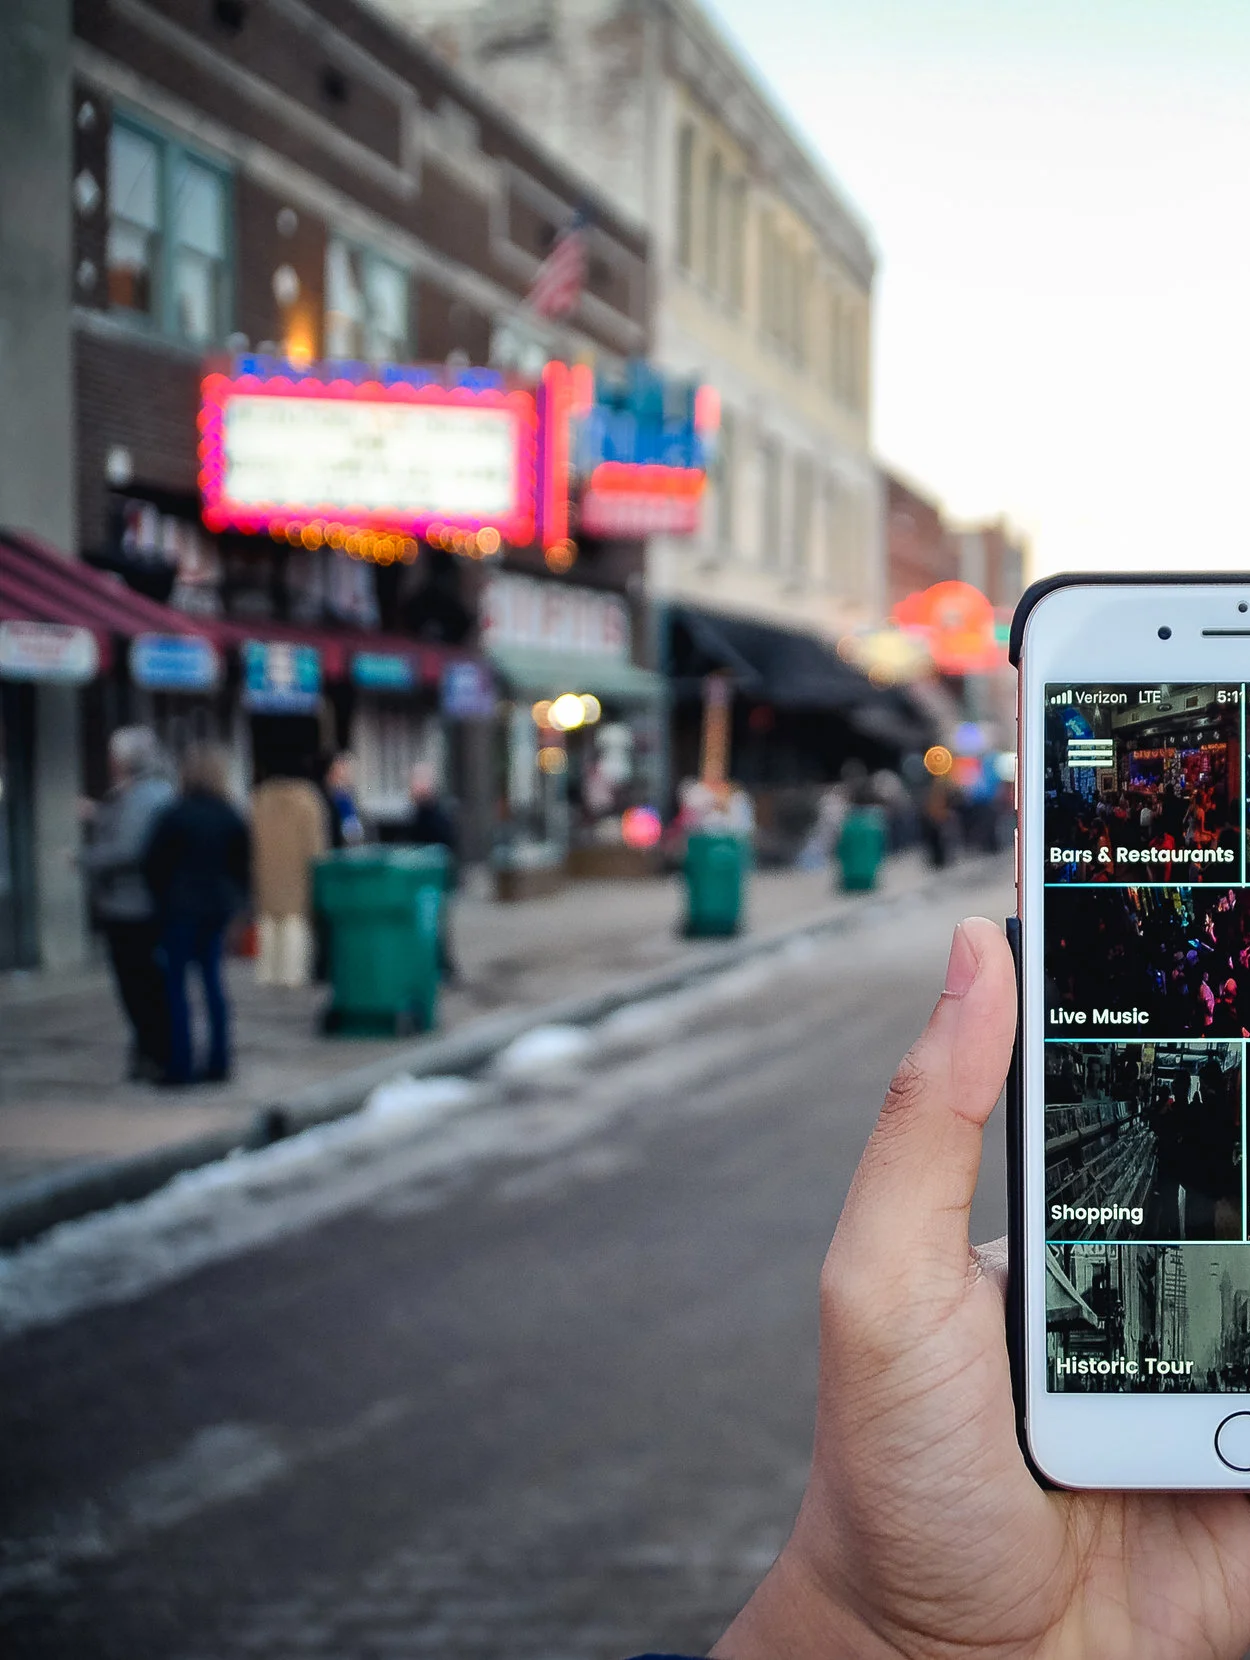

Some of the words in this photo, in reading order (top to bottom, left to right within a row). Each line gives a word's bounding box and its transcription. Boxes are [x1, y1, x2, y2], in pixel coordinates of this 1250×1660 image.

[1075, 690, 1127, 704] Verizon
[1138, 690, 1161, 704] LTE
[1050, 847, 1093, 863] Bars
[1097, 847, 1111, 863] &
[1116, 847, 1235, 863] Restaurants
[1050, 1007, 1087, 1025] Live
[1092, 1007, 1150, 1025] Music
[1051, 1203, 1144, 1226] Shopping
[1056, 1356, 1139, 1375] Historic
[1144, 1357, 1194, 1375] Tour
